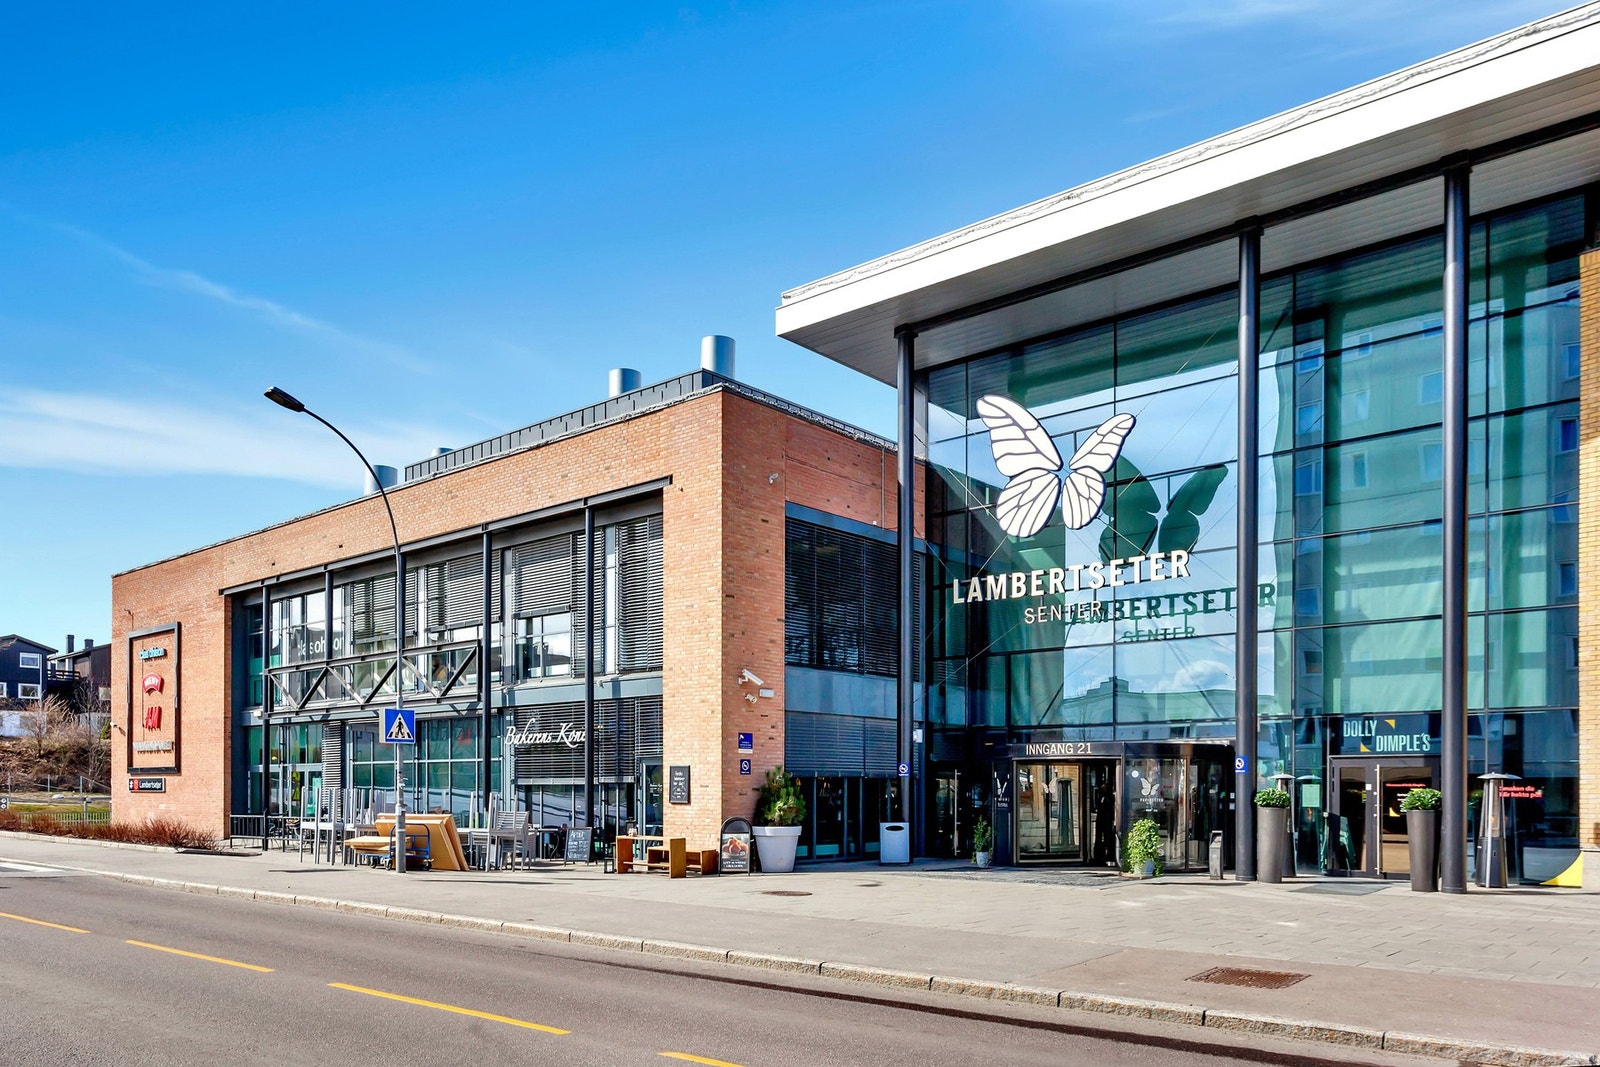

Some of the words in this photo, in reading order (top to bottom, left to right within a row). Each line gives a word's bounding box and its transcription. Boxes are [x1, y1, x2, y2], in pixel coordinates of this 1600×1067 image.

[953, 549, 1190, 604] LAMBERTSETER
[1024, 600, 1102, 624] SENTER
[504, 718, 553, 747] Bakerens
[1343, 720, 1377, 737] DOLLY
[1026, 743, 1074, 755] INNGANG
[1077, 743, 1092, 754] 21
[1376, 733, 1431, 752] DIMPLE'S
